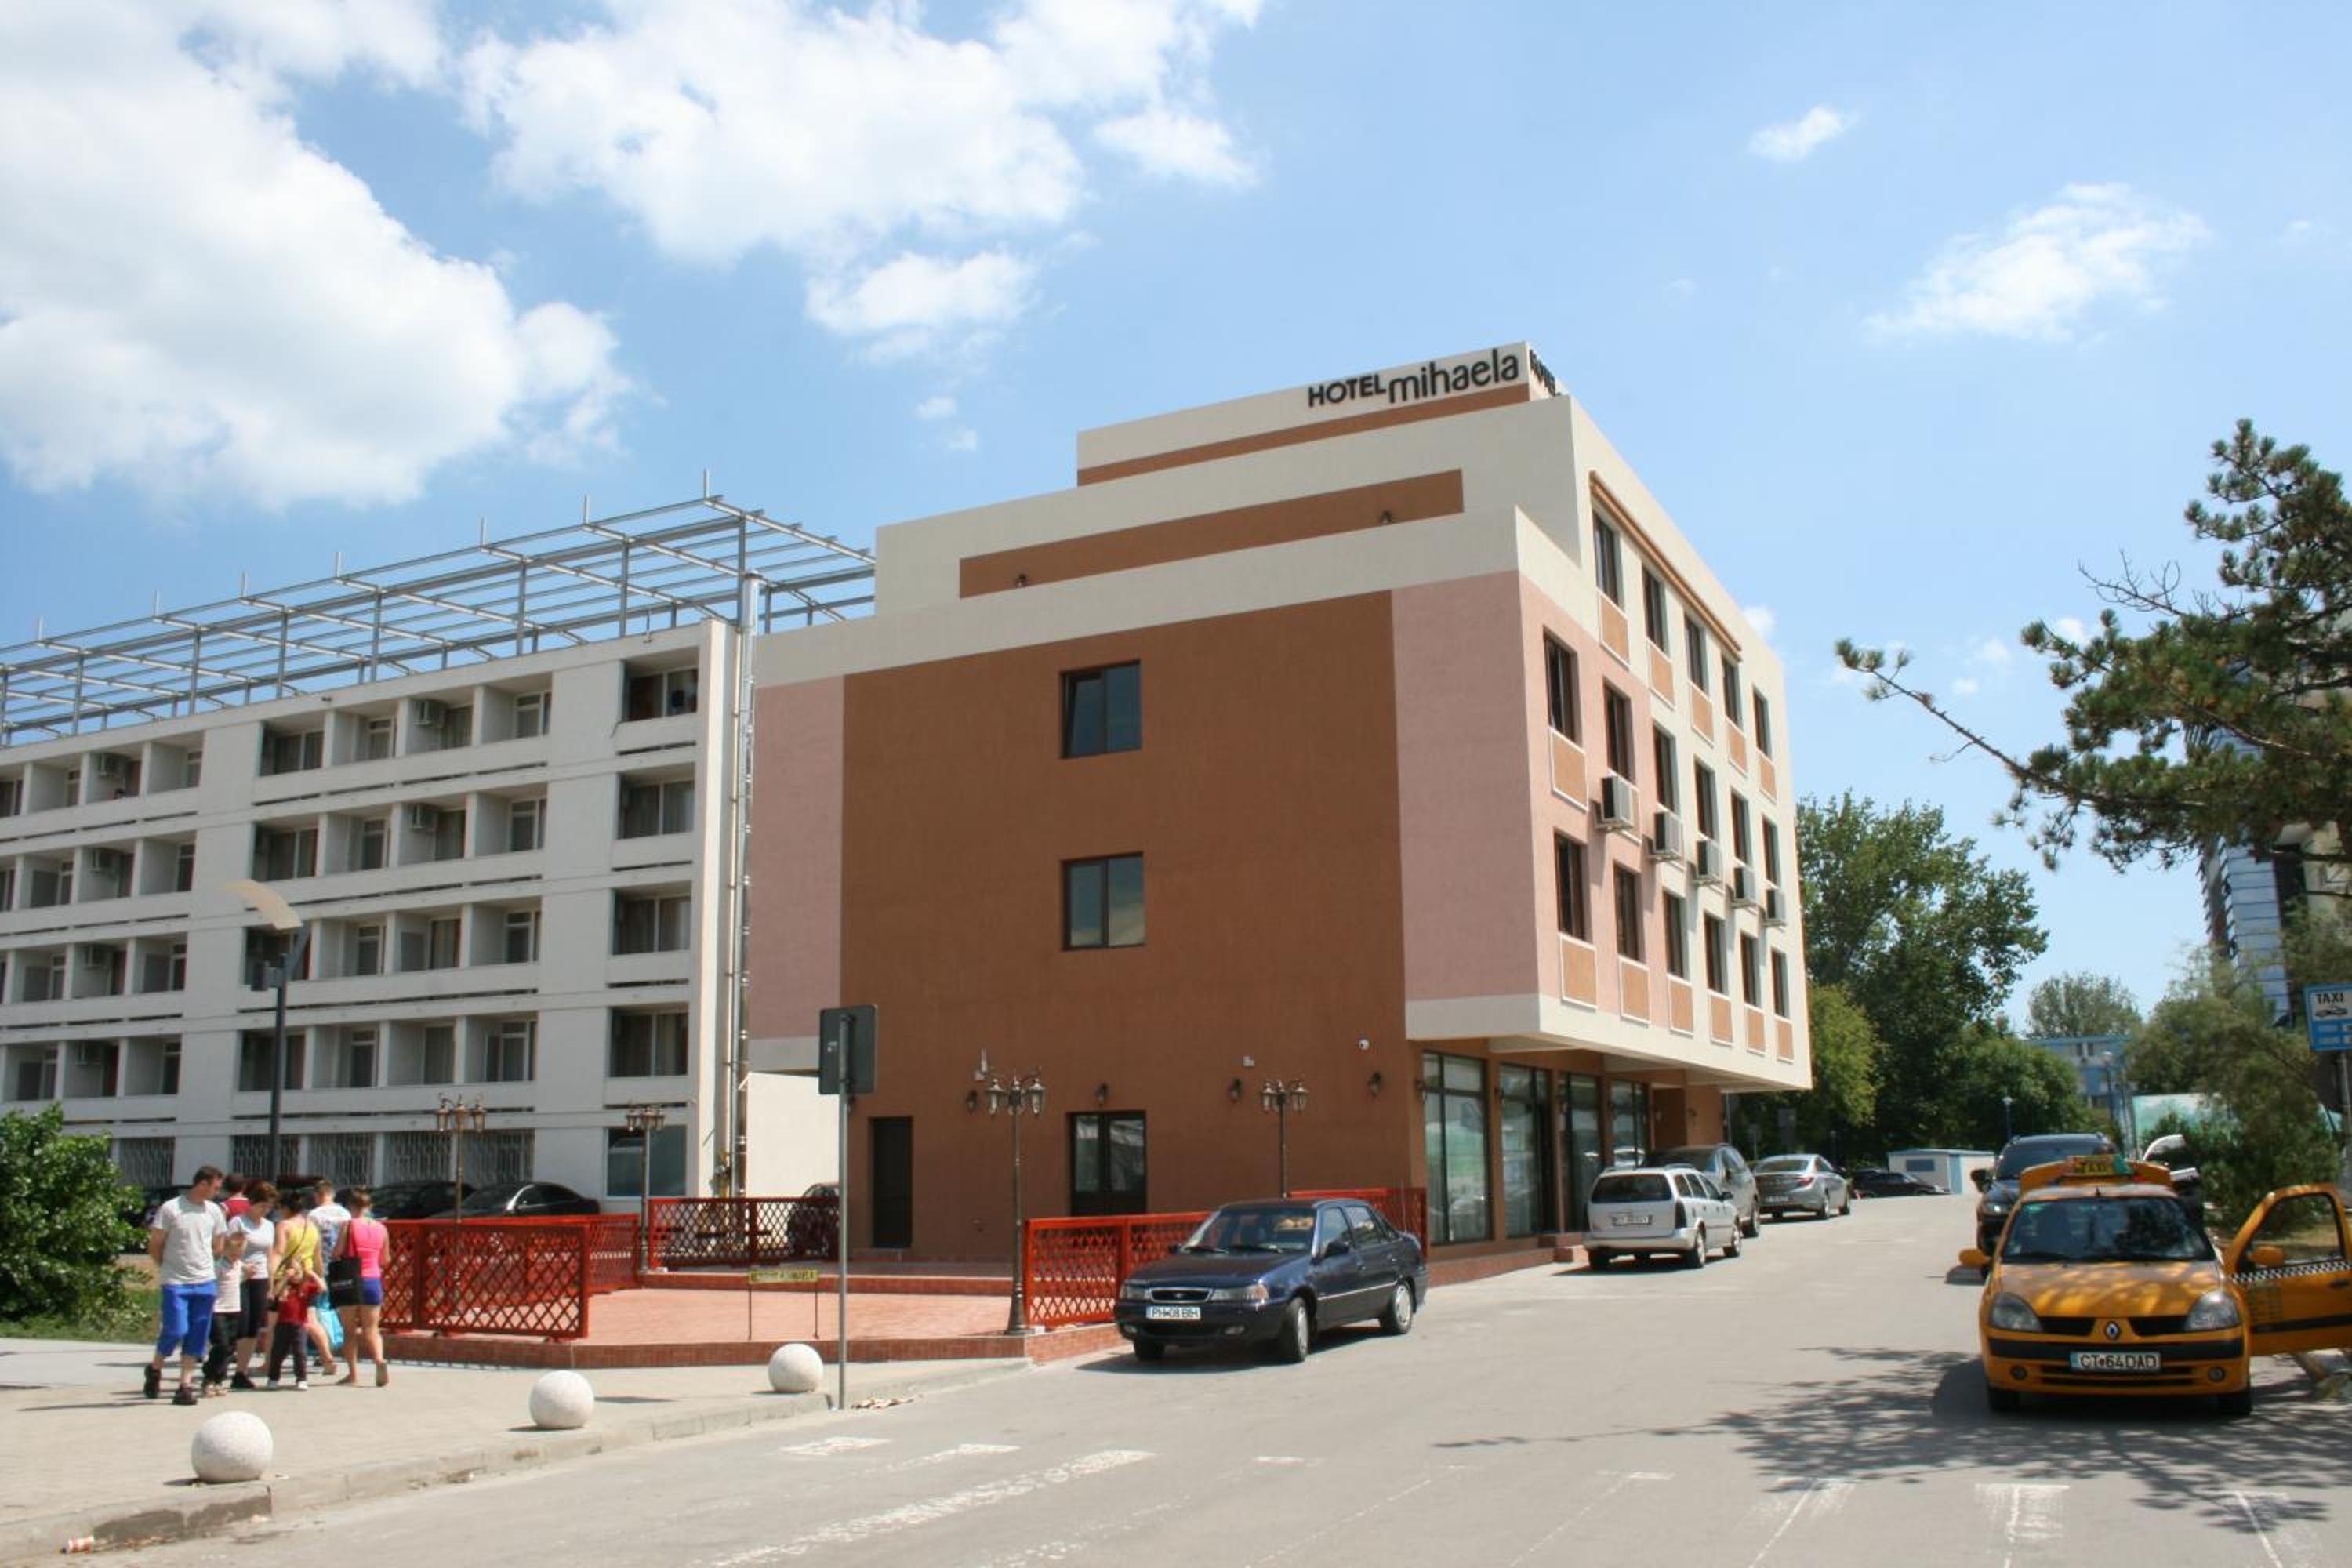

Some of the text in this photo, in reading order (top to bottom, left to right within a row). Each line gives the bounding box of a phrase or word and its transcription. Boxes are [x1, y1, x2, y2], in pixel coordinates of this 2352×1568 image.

[1308, 373, 1386, 407] HOTEL
[1389, 348, 1519, 403] mihaela
[2315, 991, 2344, 1004] TAXI
